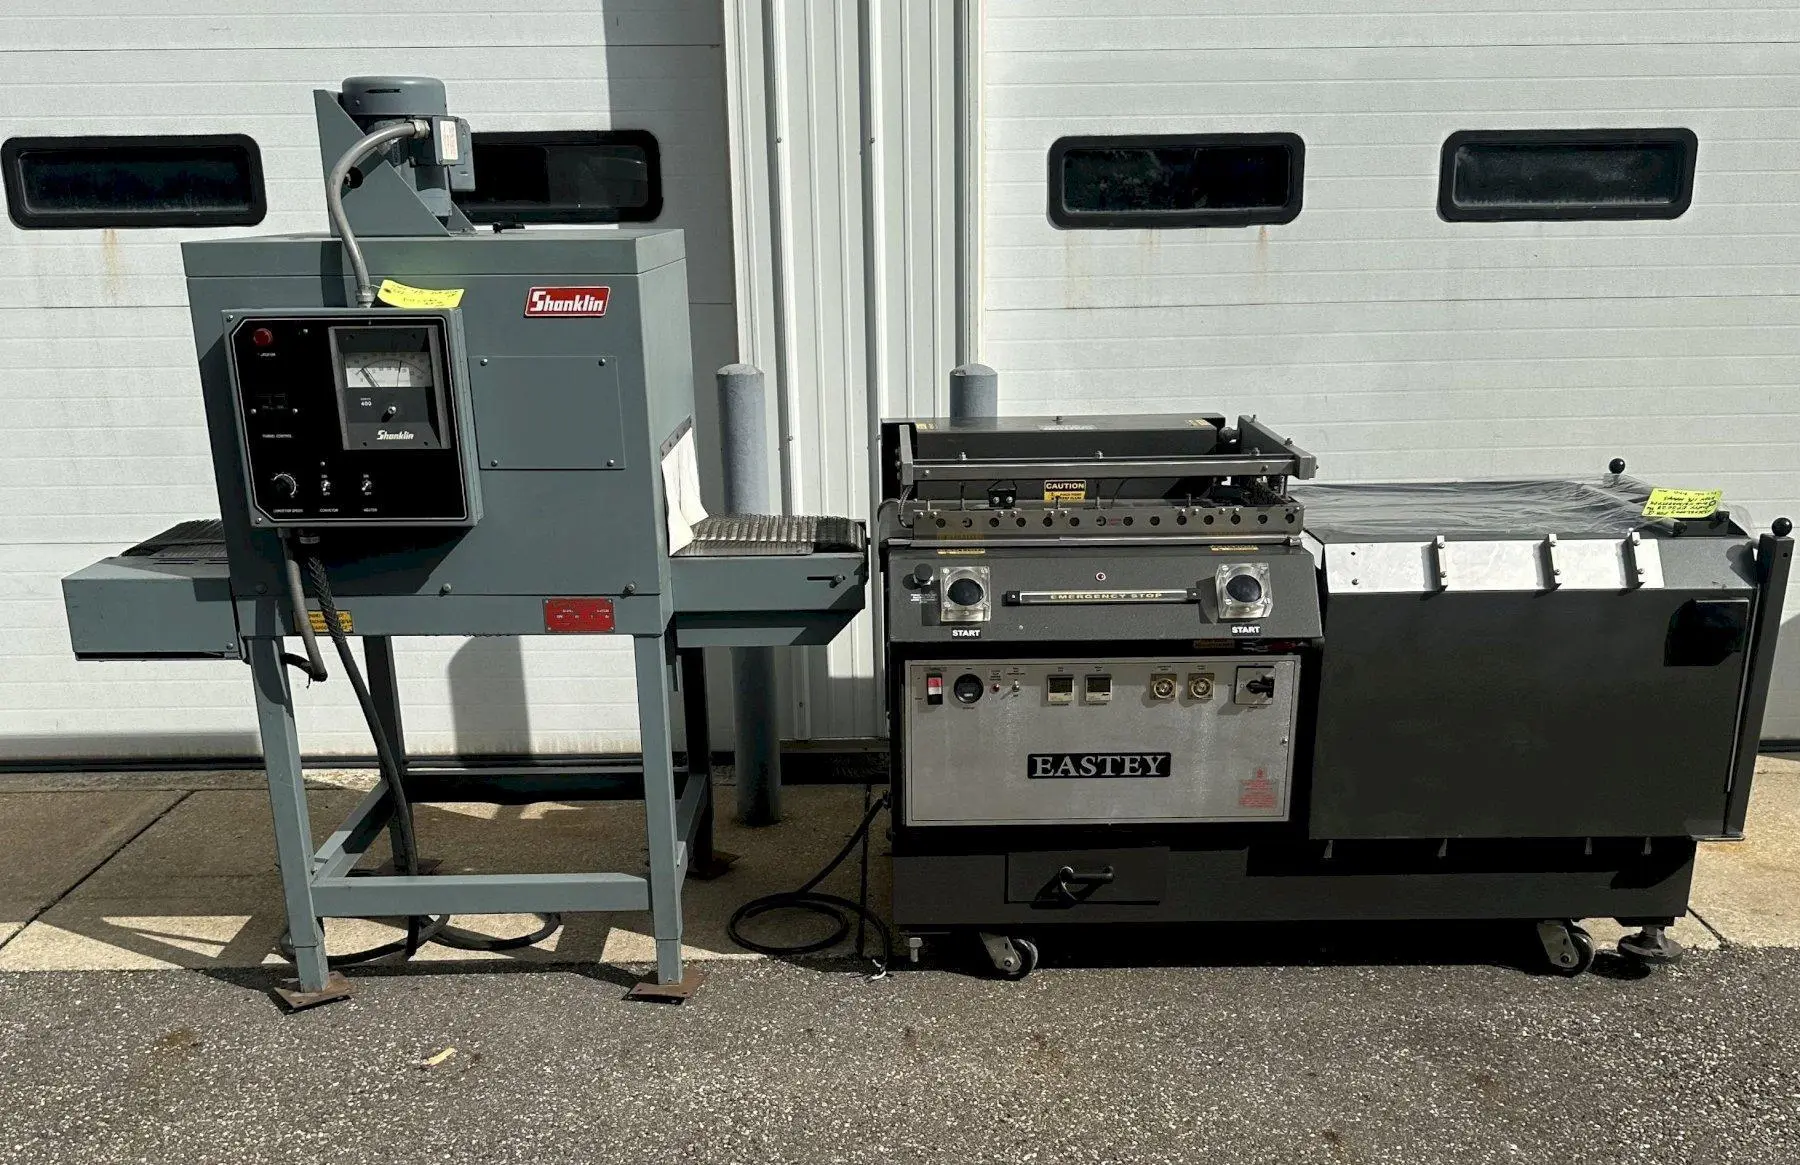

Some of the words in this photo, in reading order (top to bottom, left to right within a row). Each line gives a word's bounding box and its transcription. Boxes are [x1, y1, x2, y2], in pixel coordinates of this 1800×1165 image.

[530, 291, 604, 312] Shanklin
[376, 429, 415, 440] Shanklin
[952, 629, 981, 637] START
[1231, 626, 1261, 634] START
[1032, 755, 1167, 777] EASTEY
